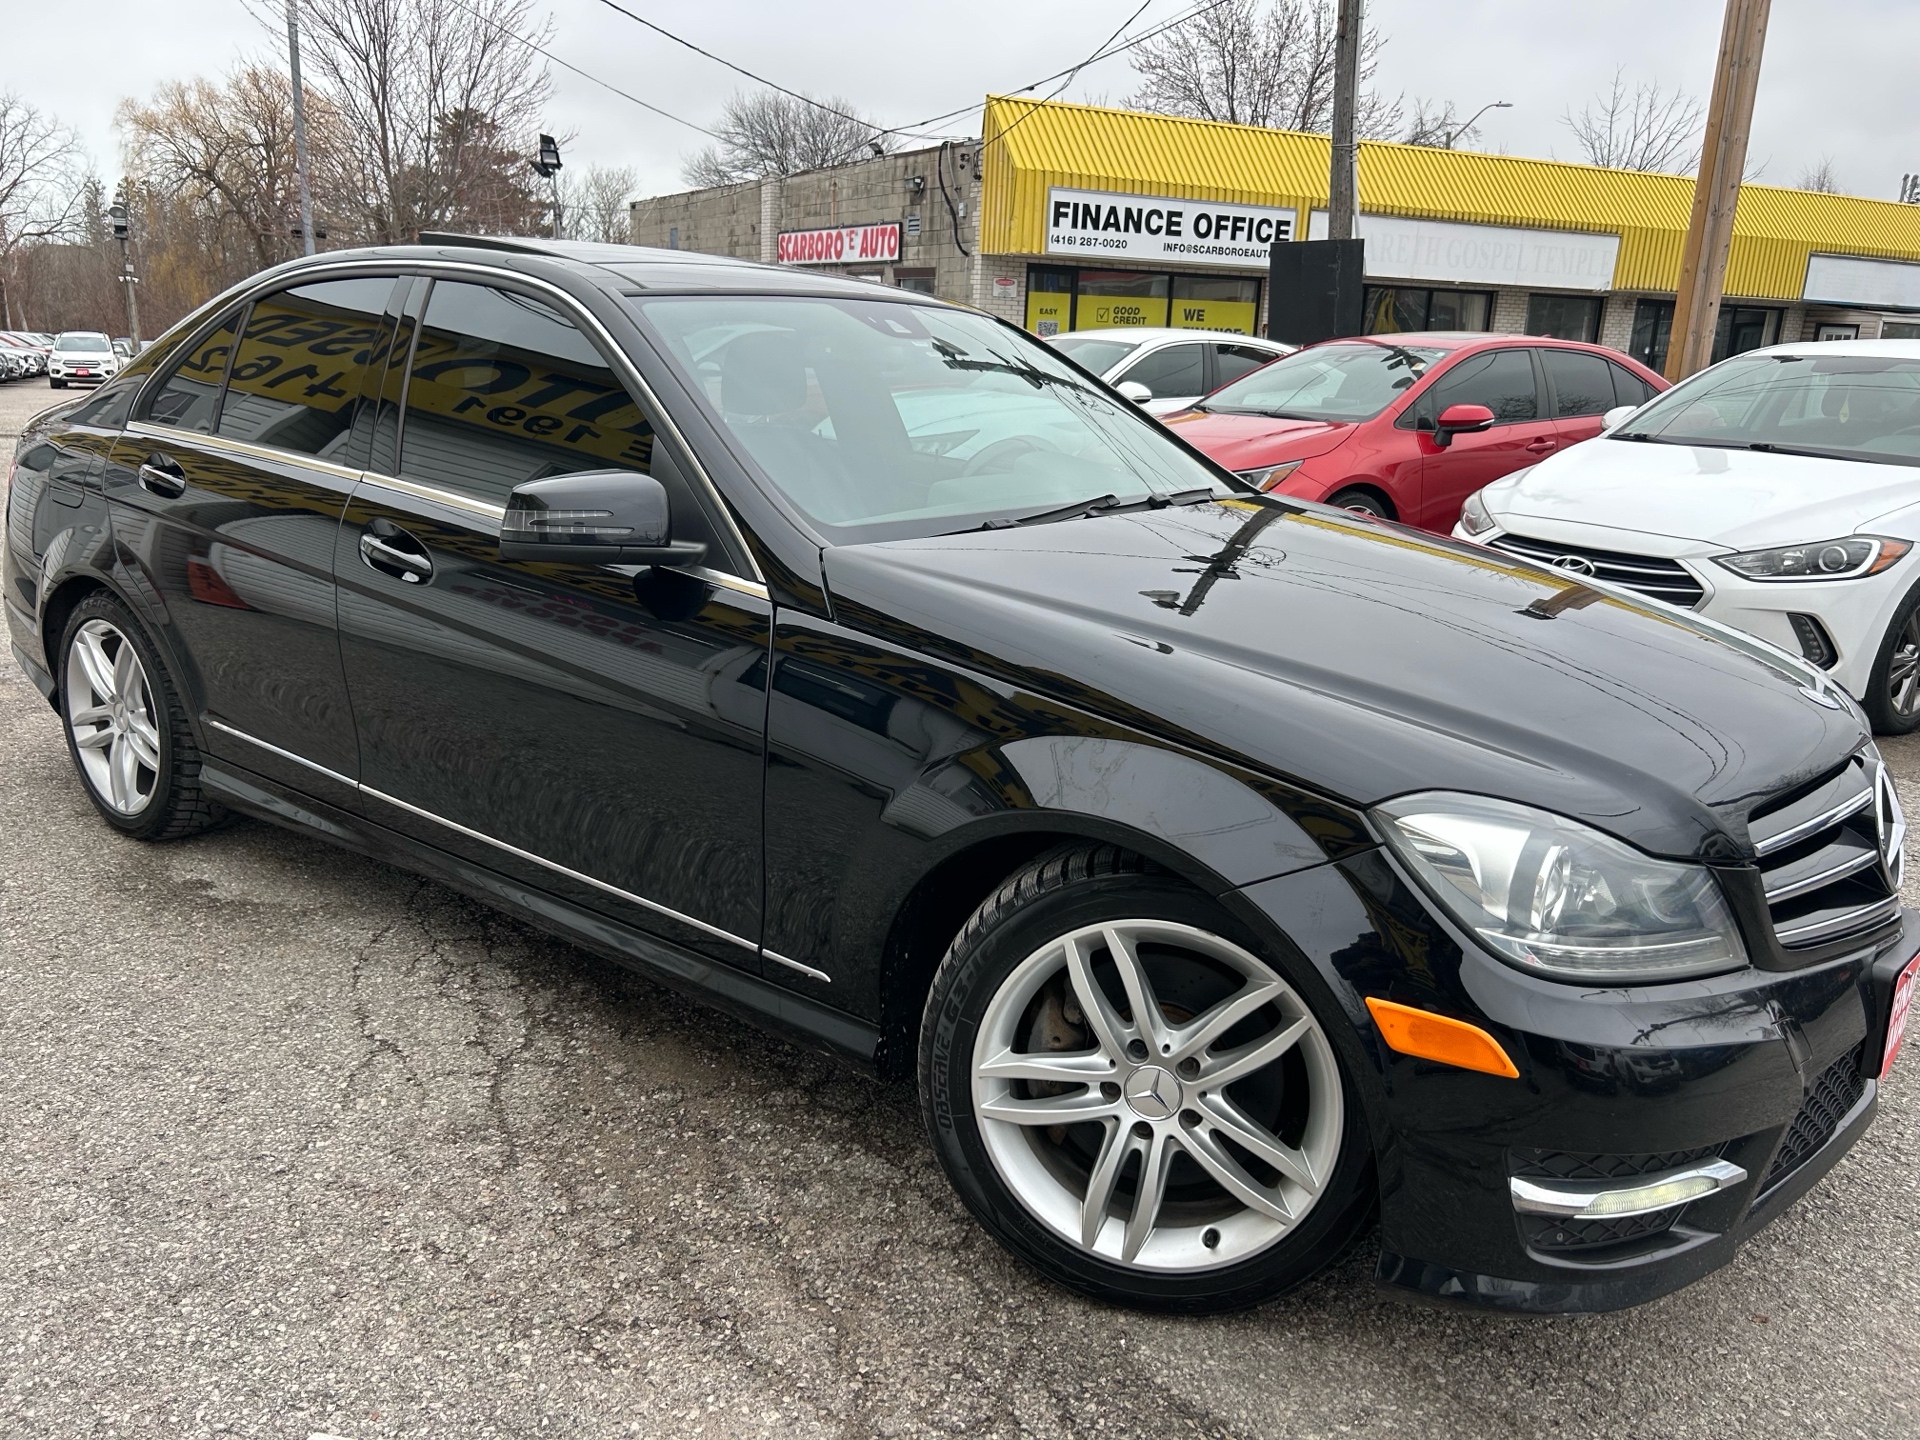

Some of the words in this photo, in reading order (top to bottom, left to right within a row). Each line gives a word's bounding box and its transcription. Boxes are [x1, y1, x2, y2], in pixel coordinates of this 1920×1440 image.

[1052, 200, 1183, 237] FINANCE
[1193, 212, 1292, 243] OFFICE
[778, 230, 844, 262] SCARBORO
[859, 225, 898, 258] AUTO
[1050, 234, 1077, 246] (416)
[1079, 236, 1128, 249] 287-0020
[1446, 238, 1527, 273] GOSPEL
[1532, 244, 1613, 278] TEMPLE
[1113, 306, 1140, 315] GOOD
[1183, 308, 1205, 322] WE
[1112, 316, 1147, 325] CREDIT
